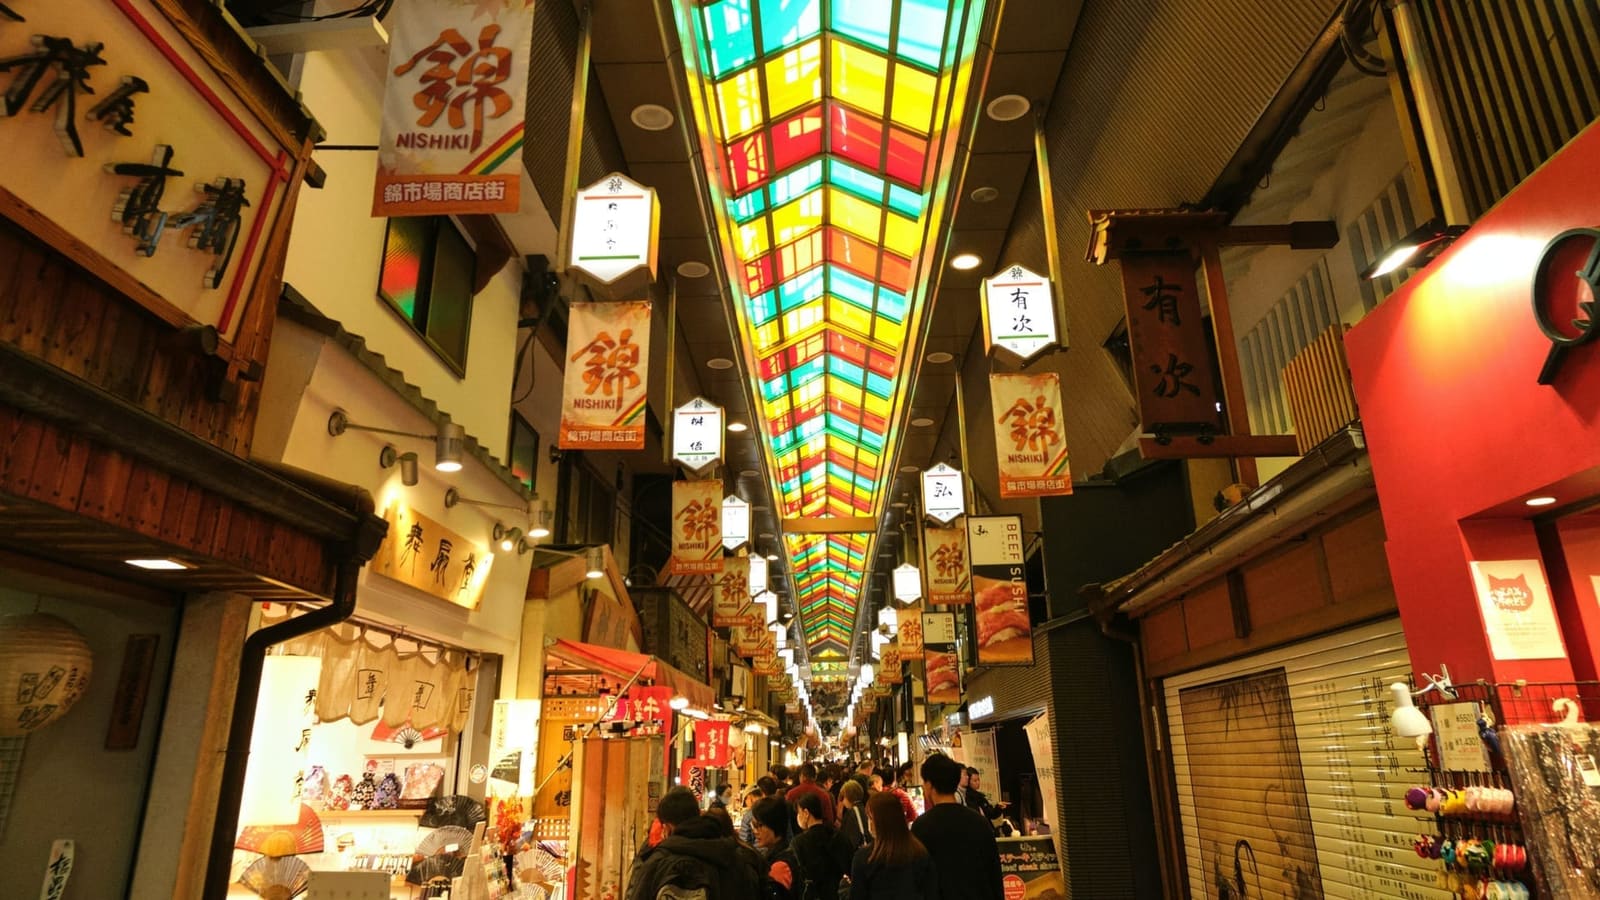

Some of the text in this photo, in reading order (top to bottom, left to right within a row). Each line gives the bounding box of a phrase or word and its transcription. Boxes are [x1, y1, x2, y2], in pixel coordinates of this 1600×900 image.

[394, 23, 513, 154] 錦
[396, 132, 470, 149] NISHIKI
[384, 181, 505, 203] 錦市場商店街
[1010, 287, 1033, 332] 有次
[1139, 275, 1201, 398] 有次
[571, 328, 641, 413] 錦
[573, 398, 616, 410] NISHIKI
[998, 395, 1060, 466] 錦
[1008, 453, 1043, 464] NISHIKI
[674, 497, 719, 551] 錦
[1007, 523, 1020, 561] BEEF
[929, 542, 964, 585] 錦
[1010, 567, 1025, 613] SUSHI
